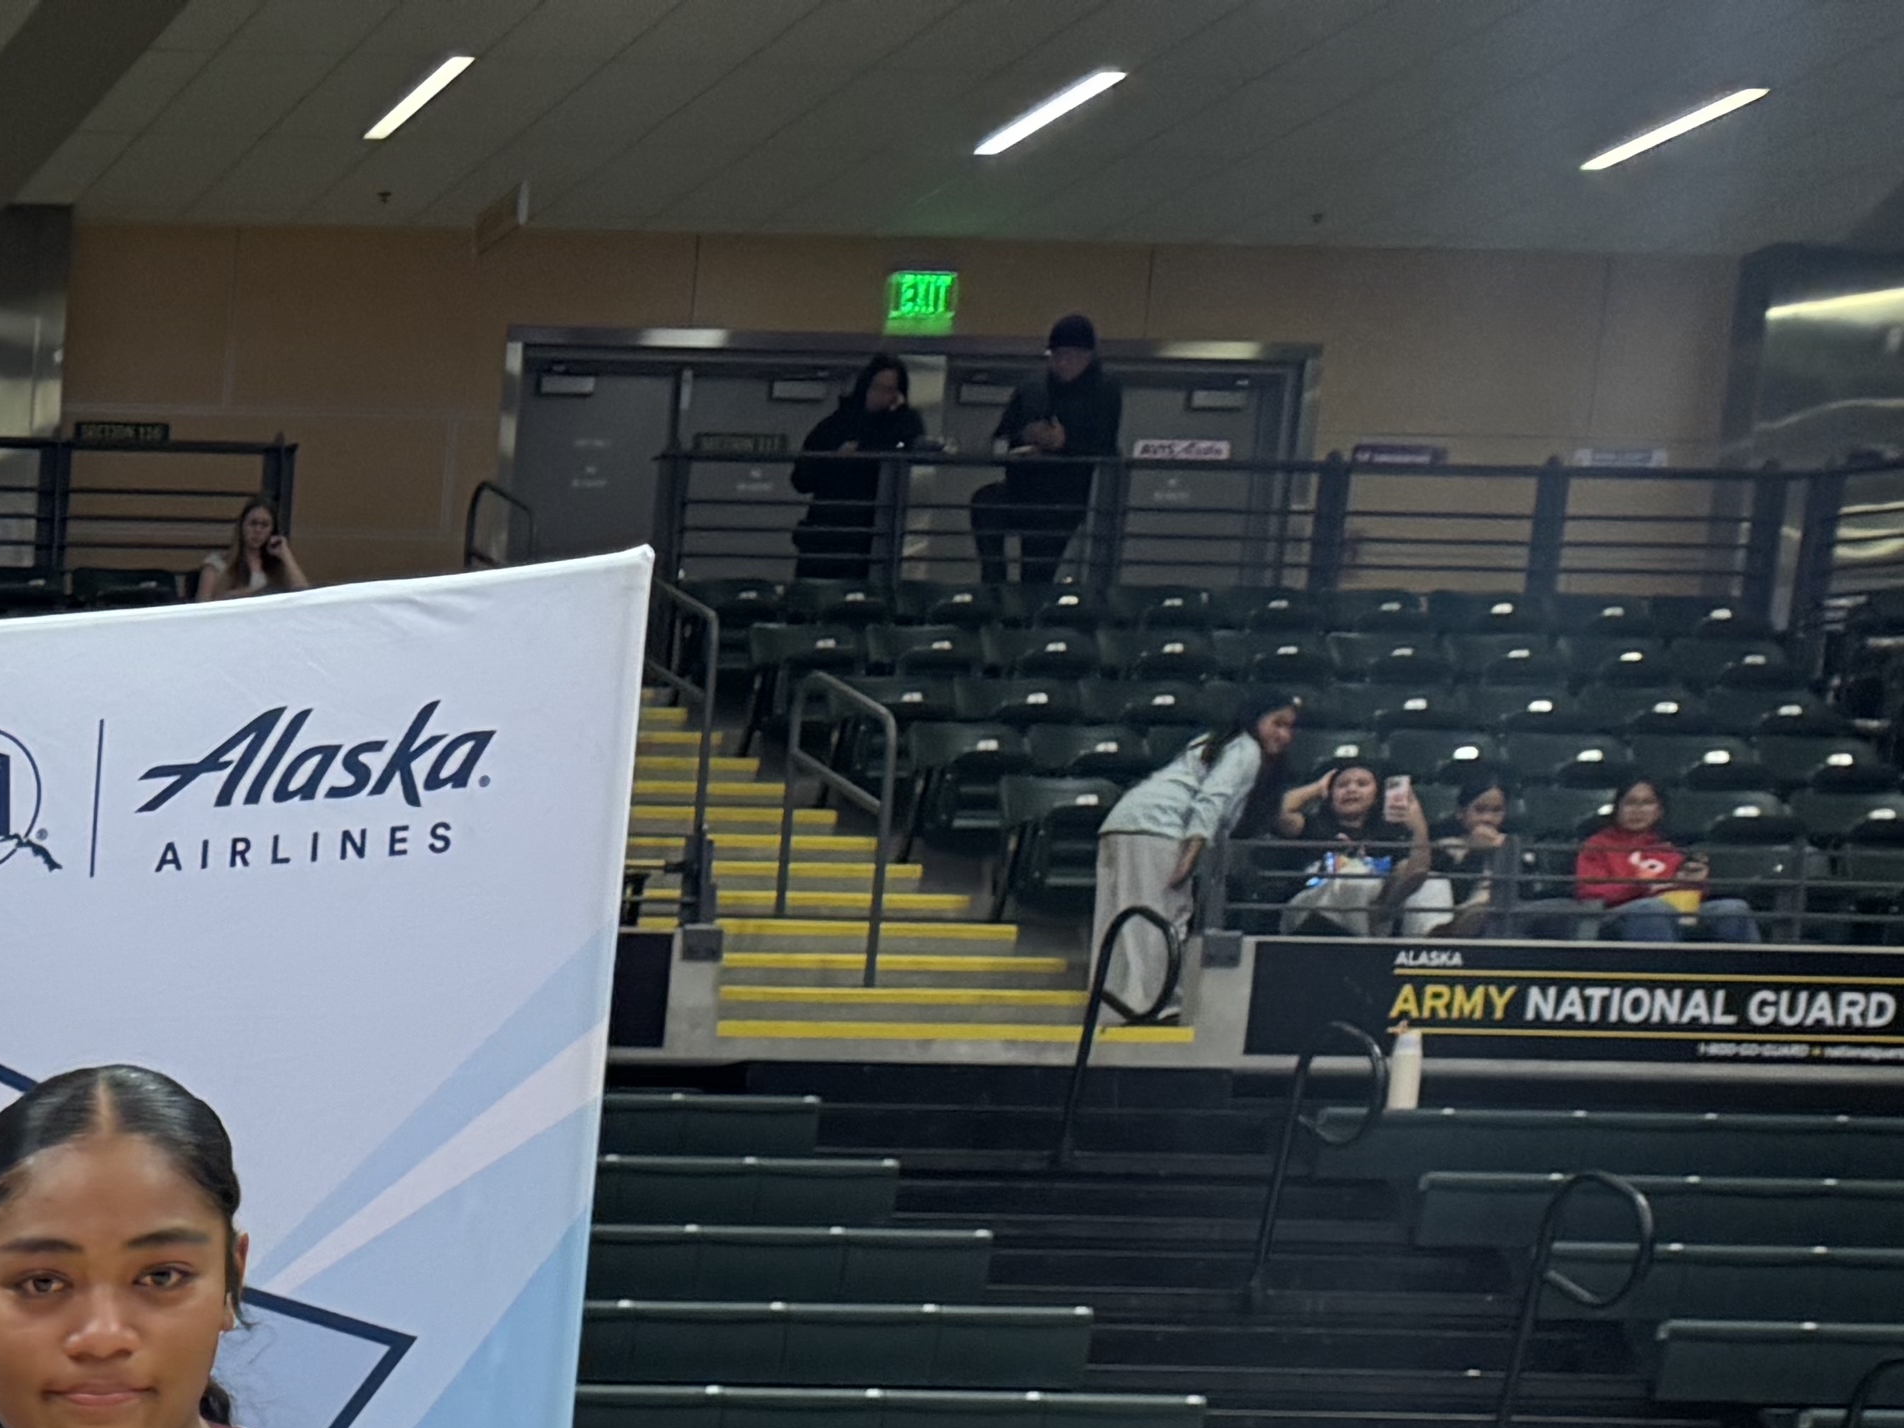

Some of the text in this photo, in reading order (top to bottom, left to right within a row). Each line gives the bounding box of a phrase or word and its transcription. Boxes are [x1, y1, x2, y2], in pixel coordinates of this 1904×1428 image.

[901, 274, 953, 313] EXIT
[135, 699, 498, 814] Alaska
[154, 821, 454, 874] AIRLINES
[1393, 950, 1463, 968] ALASKA
[1388, 983, 1898, 1029] ARMY NATIONAL GUARD
